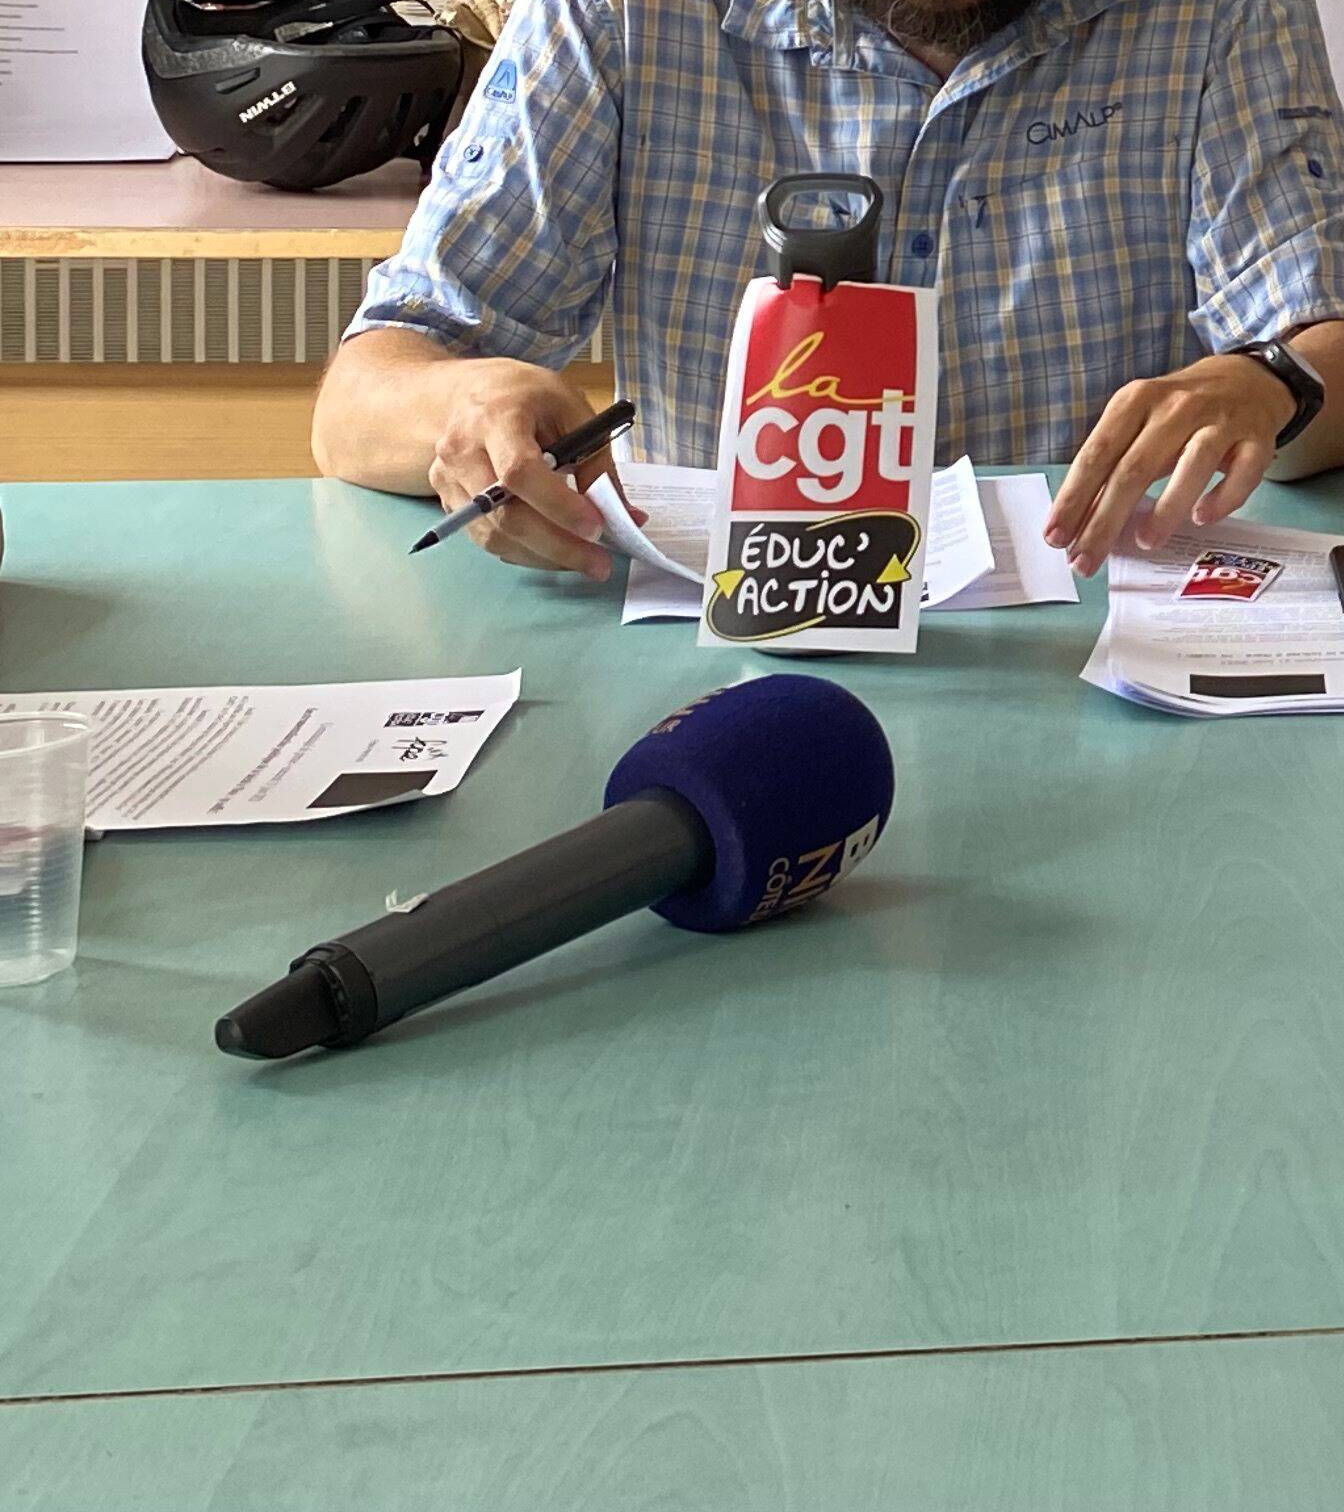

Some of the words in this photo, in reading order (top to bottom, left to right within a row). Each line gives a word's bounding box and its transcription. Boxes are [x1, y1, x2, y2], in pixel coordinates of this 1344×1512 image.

[239, 81, 297, 123] BTWIN
[745, 331, 890, 405] la
[734, 389, 915, 504] cgt
[739, 522, 870, 571] ÉDUC'
[737, 568, 895, 616] ACTION
